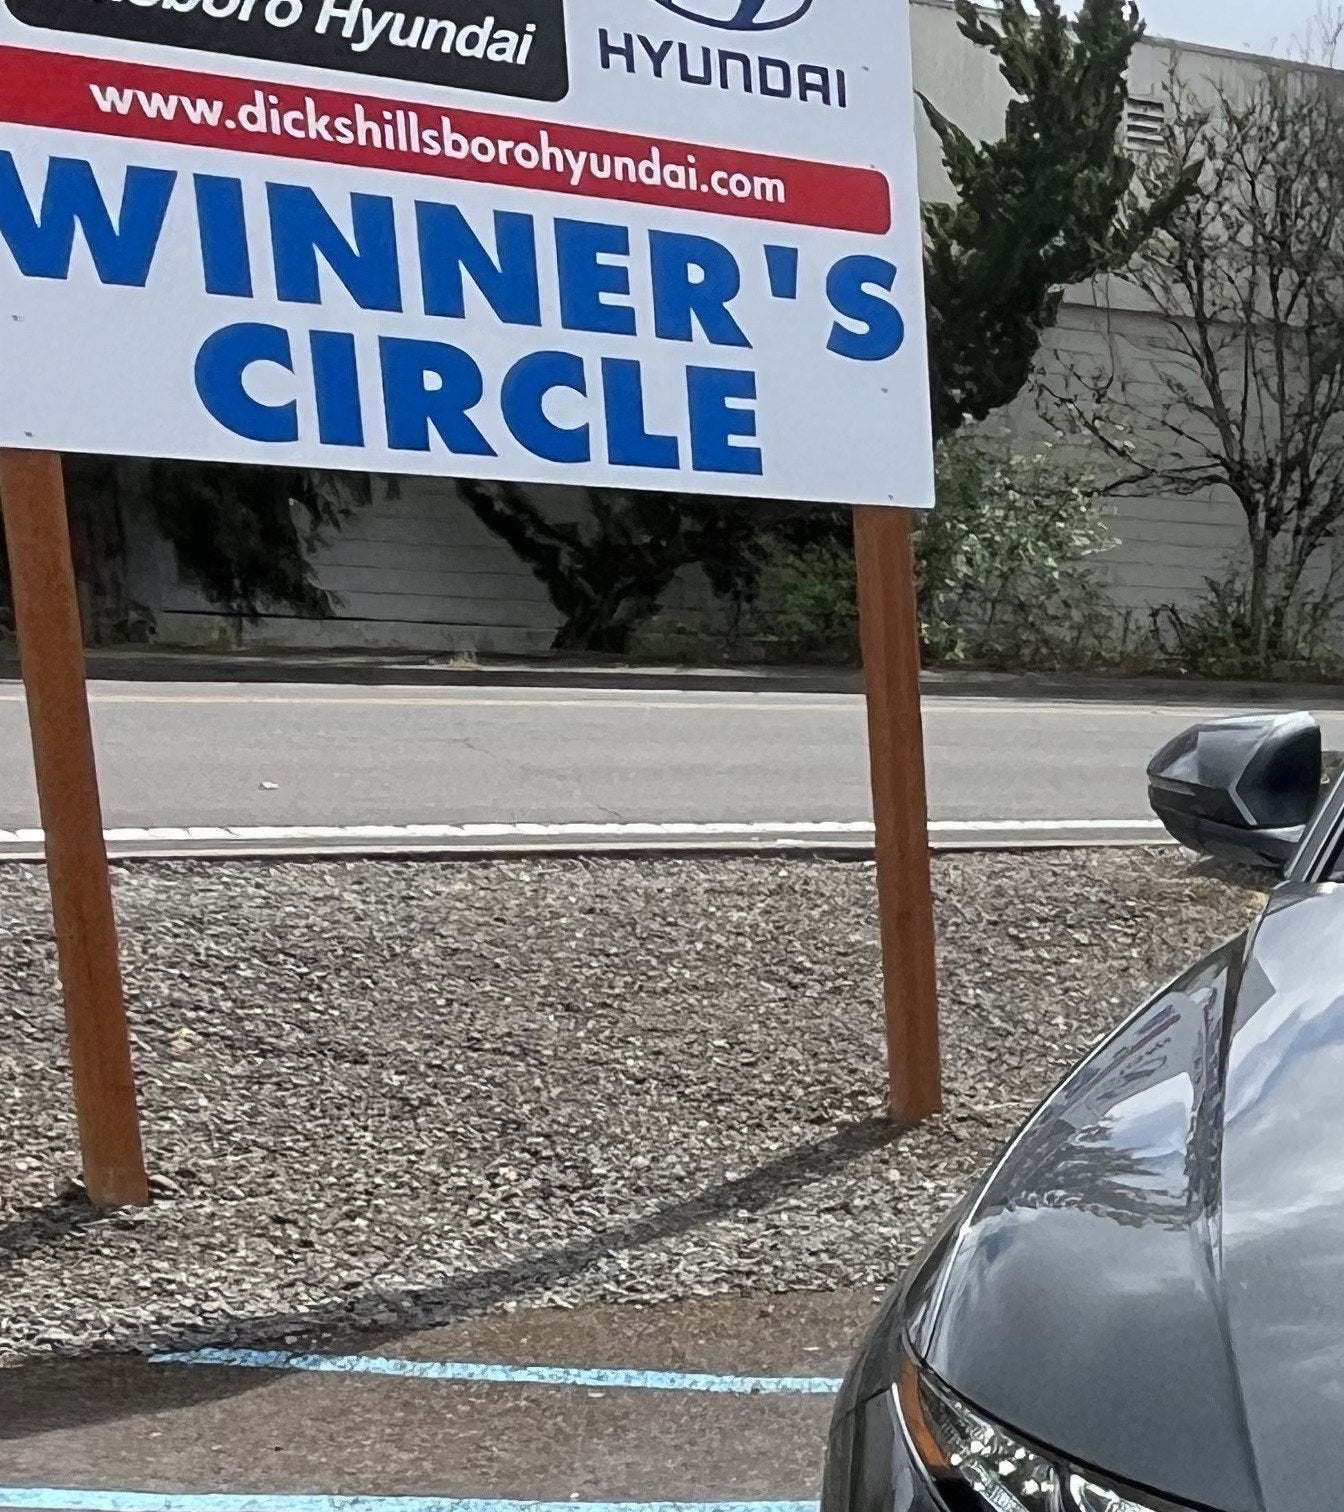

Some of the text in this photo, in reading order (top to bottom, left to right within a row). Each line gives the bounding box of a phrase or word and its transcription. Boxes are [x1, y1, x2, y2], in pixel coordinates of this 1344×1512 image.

[315, 0, 537, 66] Hyundai
[598, 28, 847, 109] HYUNDAI
[88, 83, 786, 205] www.dickshillsborohyundai.com
[0, 150, 905, 363] WINNER'S
[194, 322, 763, 476] CIRCLE
